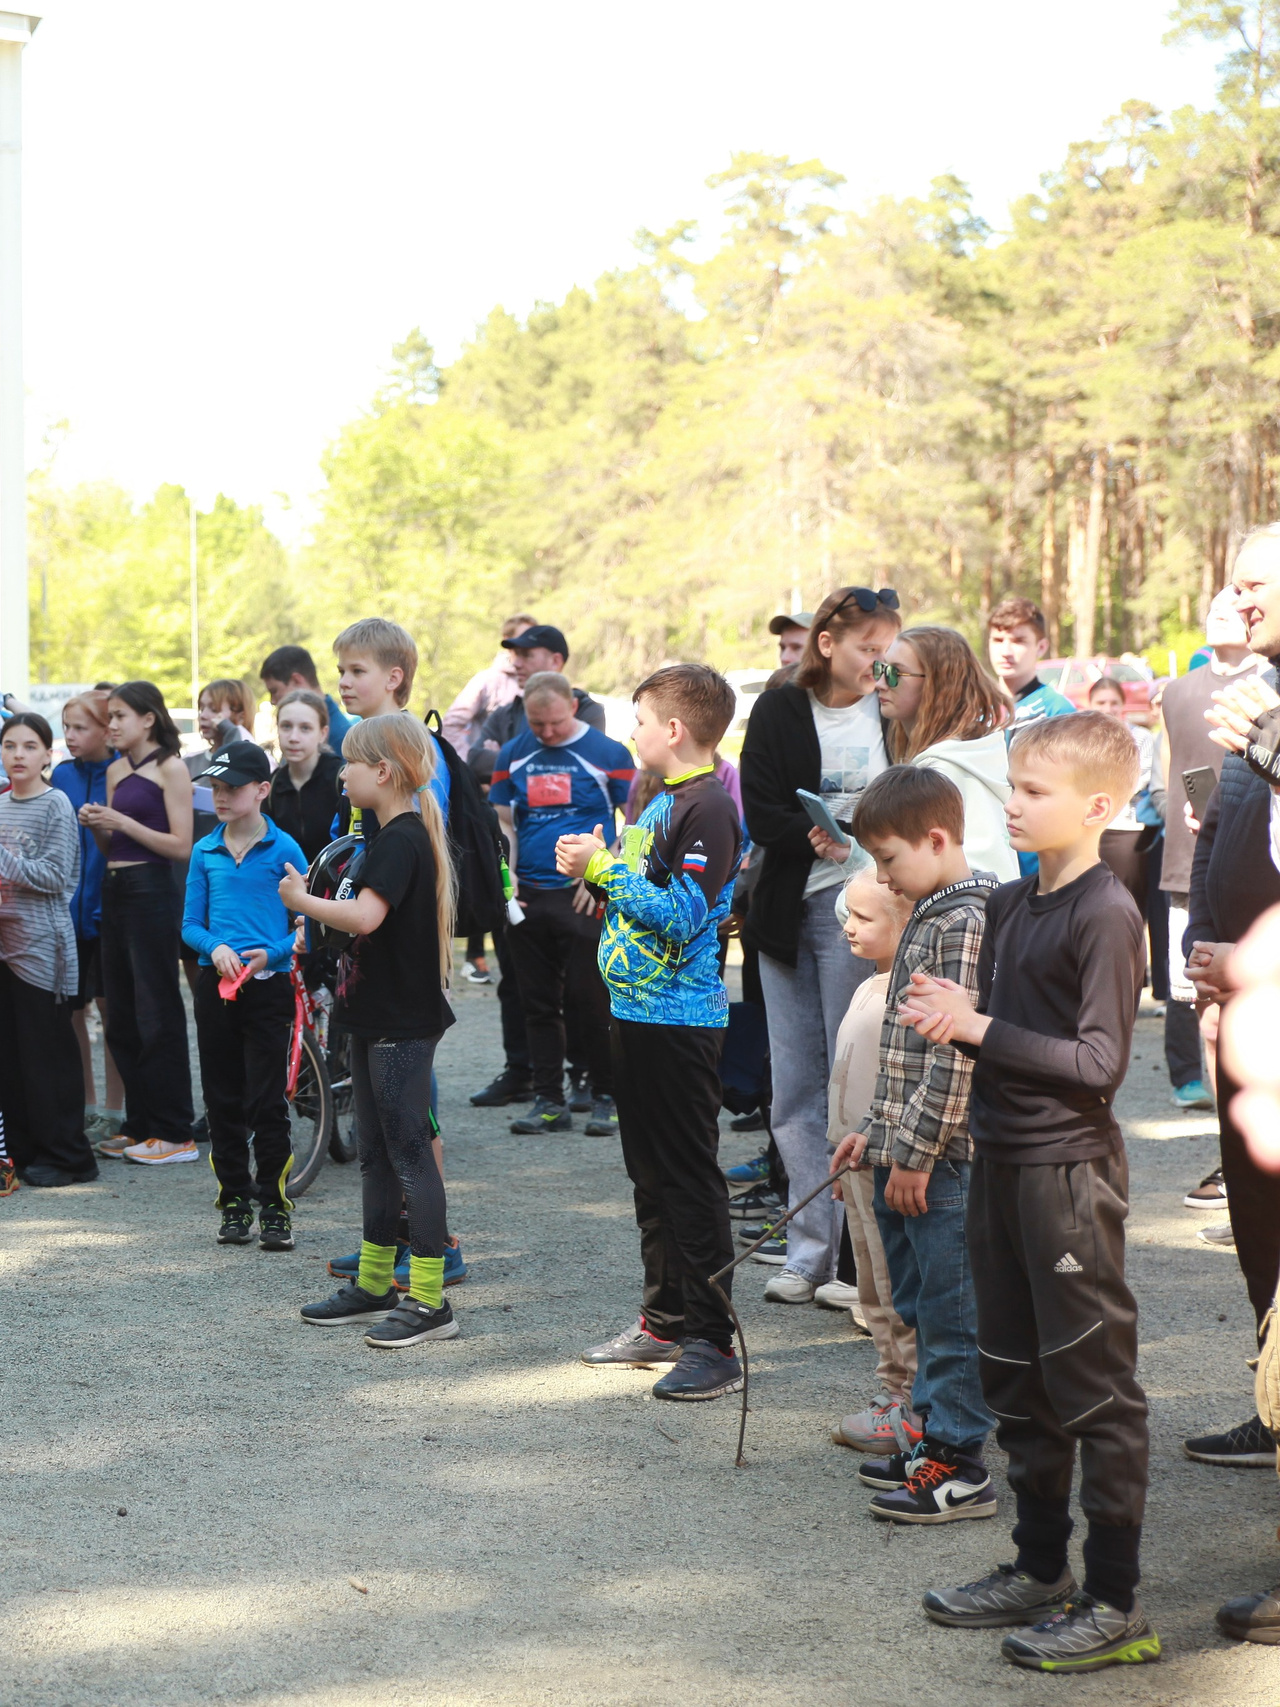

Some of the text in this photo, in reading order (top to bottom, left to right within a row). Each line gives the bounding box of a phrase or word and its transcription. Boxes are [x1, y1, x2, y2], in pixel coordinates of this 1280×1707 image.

[954, 880, 976, 890] MAKE
[978, 879, 992, 888] FUN
[1053, 1264, 1083, 1273] adidas
